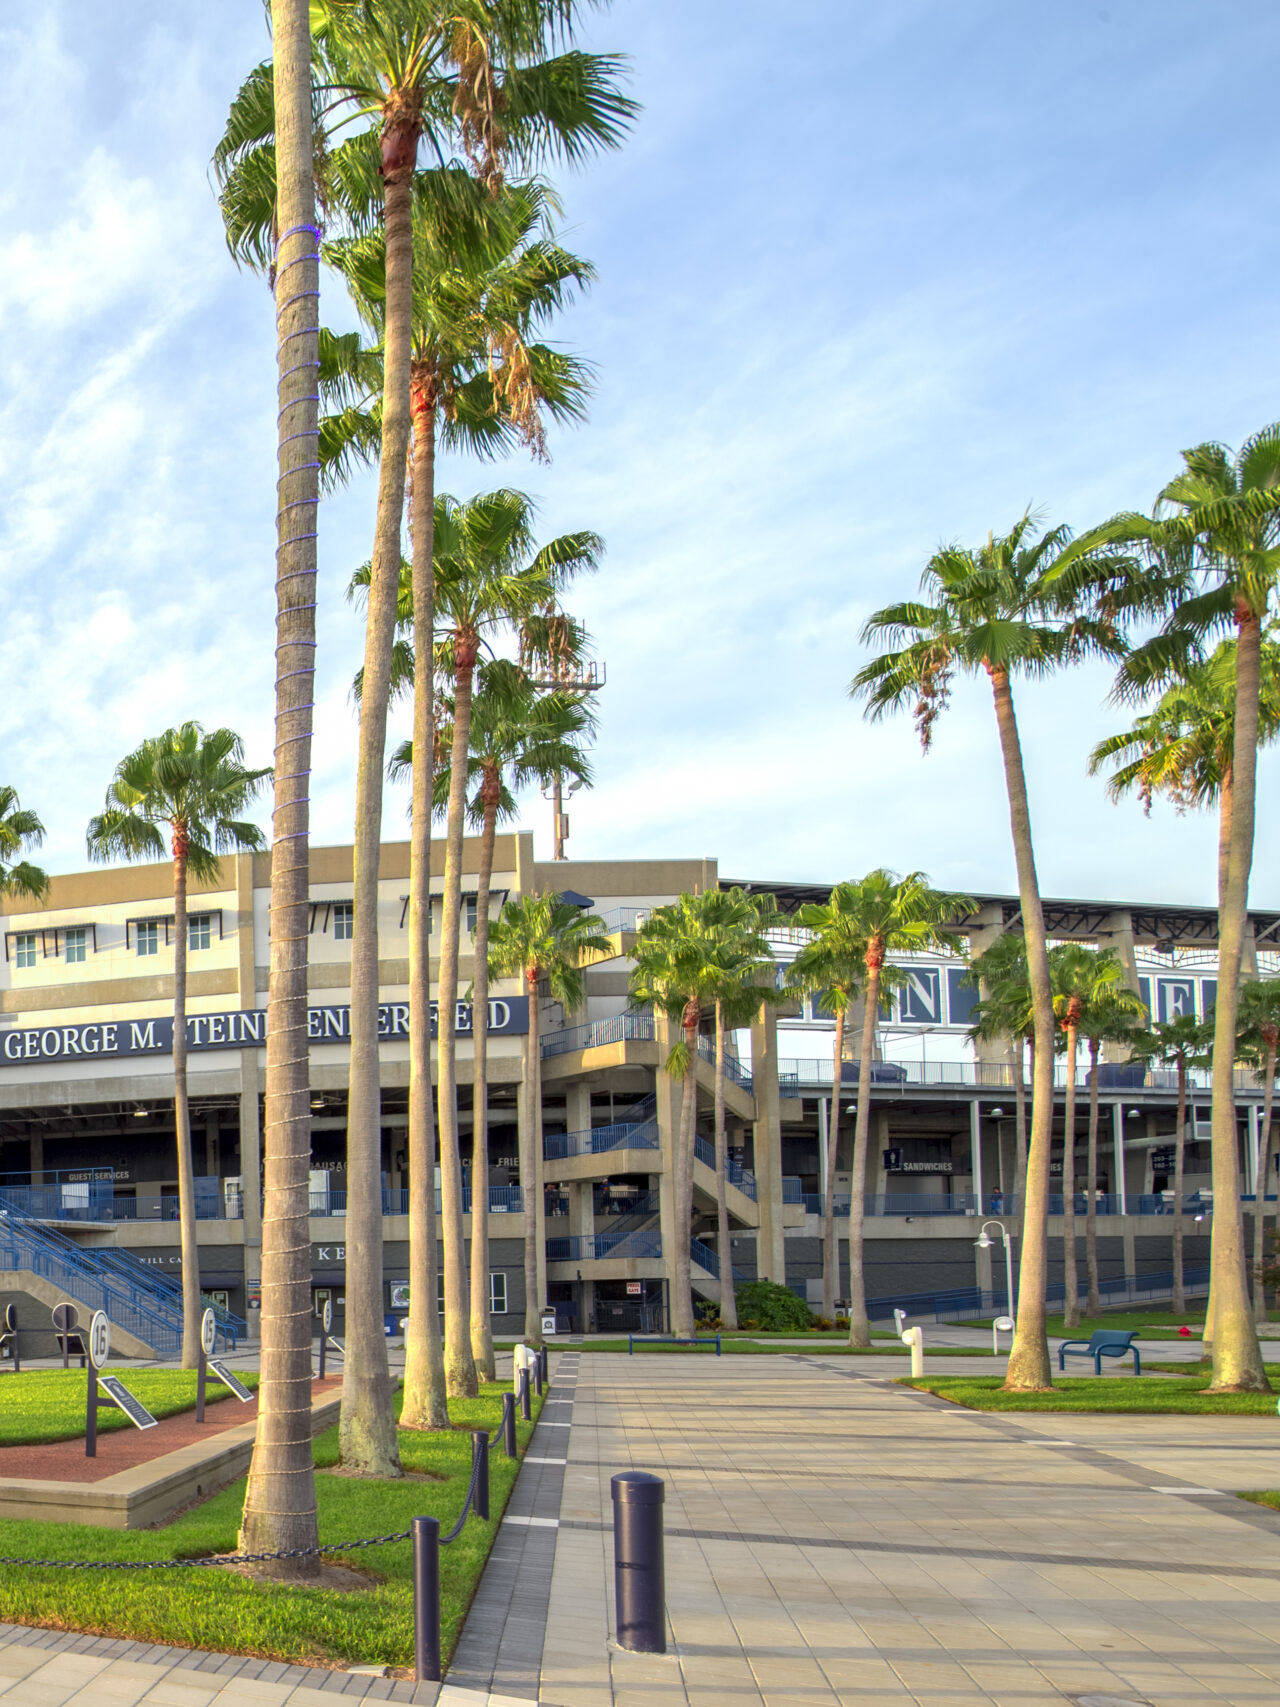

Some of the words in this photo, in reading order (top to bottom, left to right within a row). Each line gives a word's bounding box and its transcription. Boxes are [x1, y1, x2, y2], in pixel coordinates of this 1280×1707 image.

[4, 1024, 118, 1060] GEORGE
[129, 1021, 162, 1050] M.
[69, 1173, 92, 1181] GUEST
[95, 1171, 130, 1180] SERVICES
[903, 1162, 953, 1171] SANDWICHES
[95, 1325, 107, 1356] 16
[205, 1319, 213, 1344] 15
